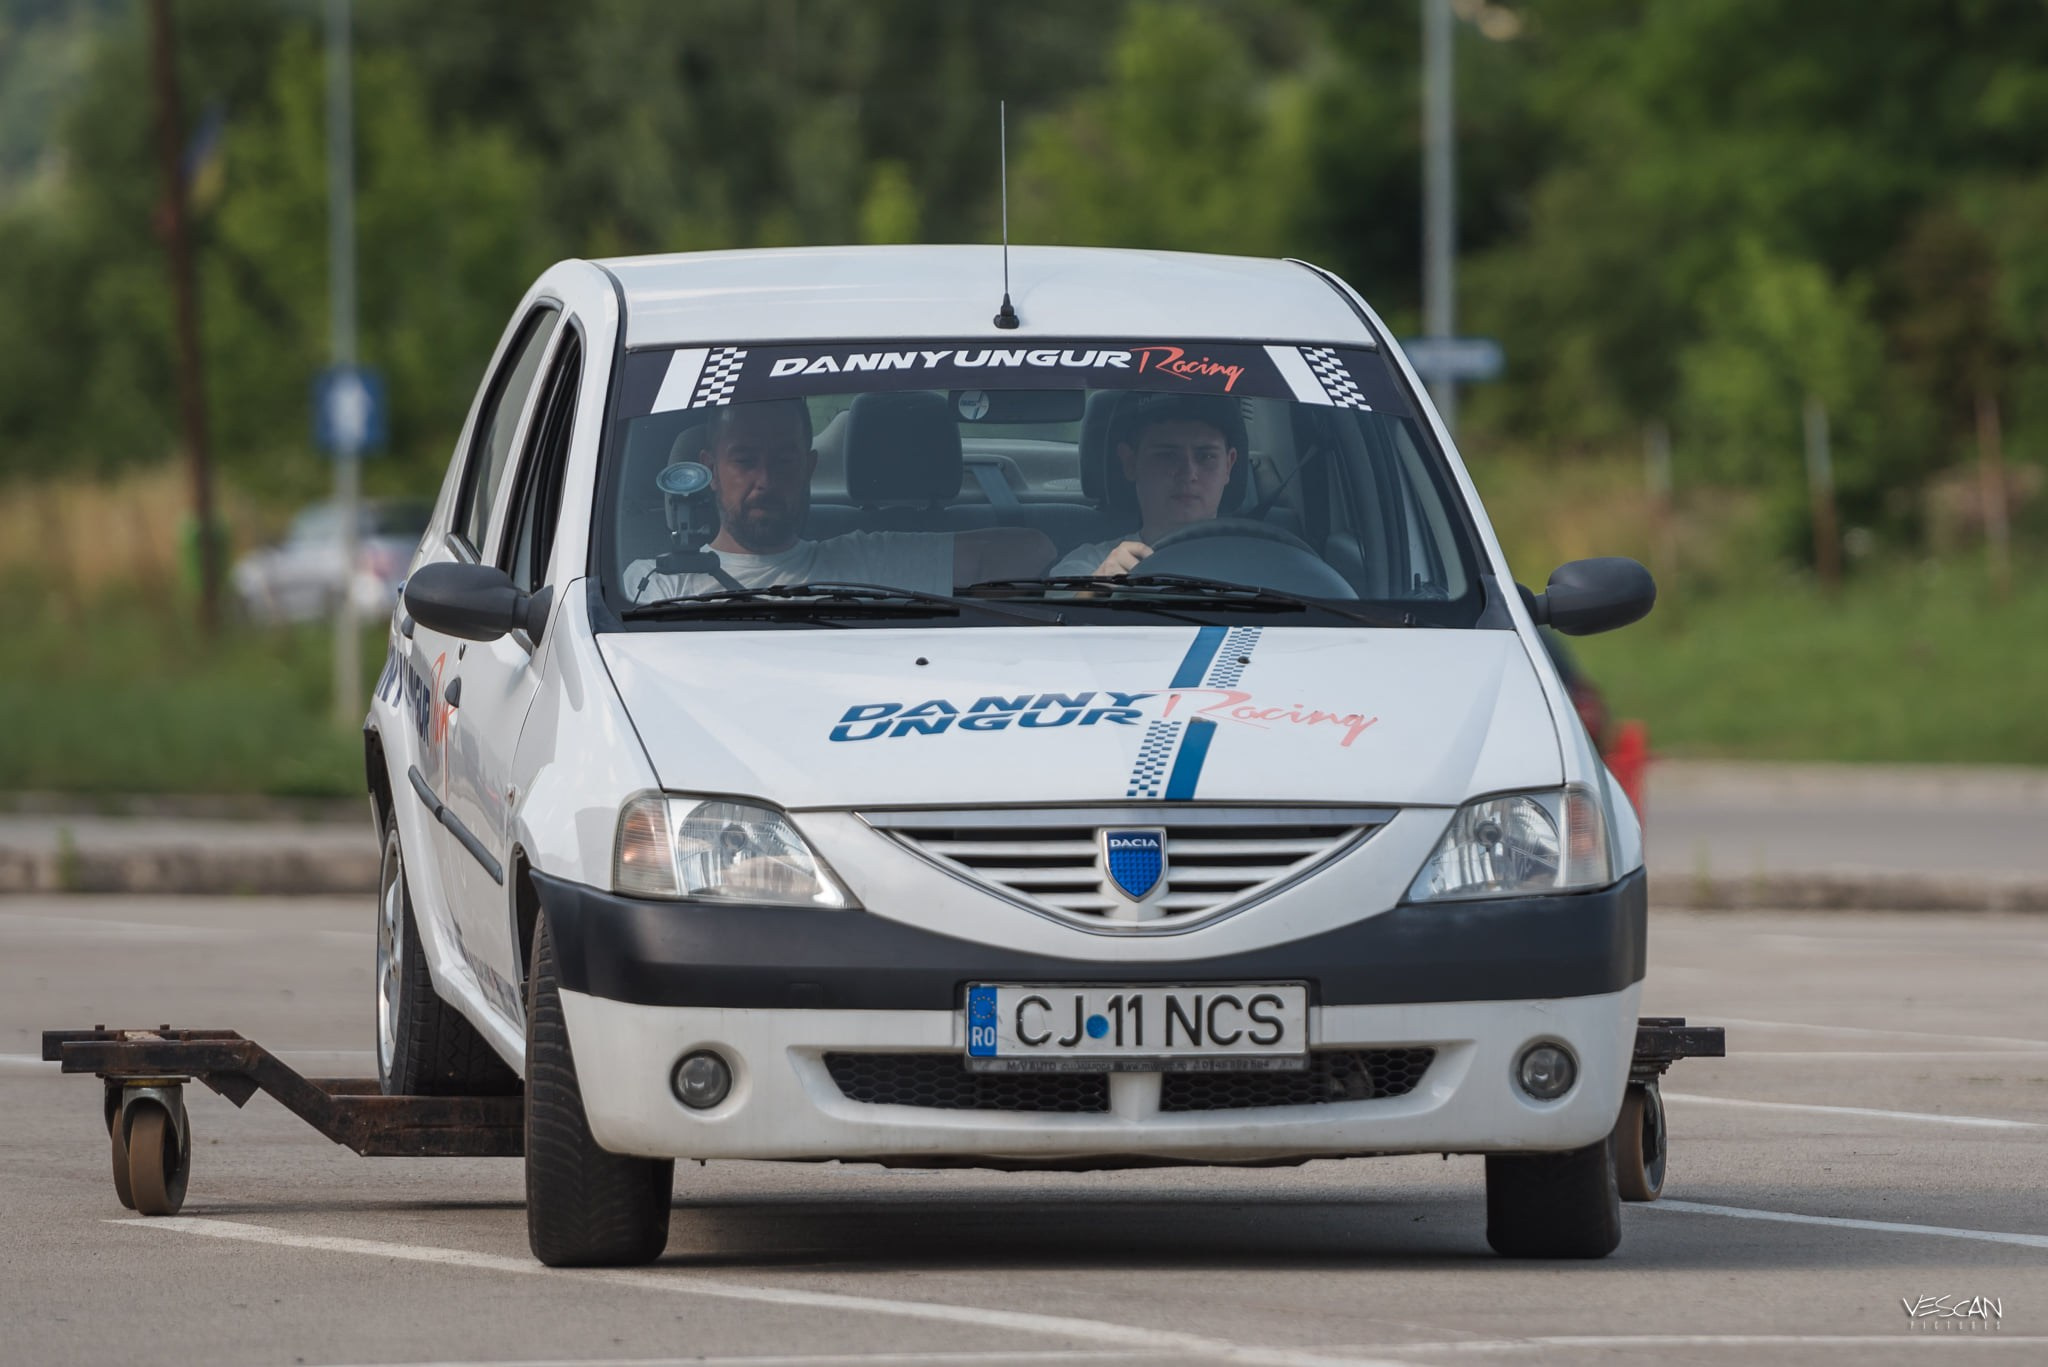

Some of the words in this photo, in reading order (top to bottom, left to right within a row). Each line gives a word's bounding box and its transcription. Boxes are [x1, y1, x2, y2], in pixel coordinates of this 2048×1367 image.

[1129, 346, 1245, 393] Racing
[837, 691, 1161, 723] DANNY
[1143, 689, 1379, 748] Racing
[828, 708, 1145, 742] UNGUR
[1110, 838, 1159, 848] DACIA
[971, 1026, 995, 1047] RO
[1015, 994, 1084, 1048] CJ
[1107, 994, 1144, 1047] 11
[1165, 993, 1285, 1047] NCS
